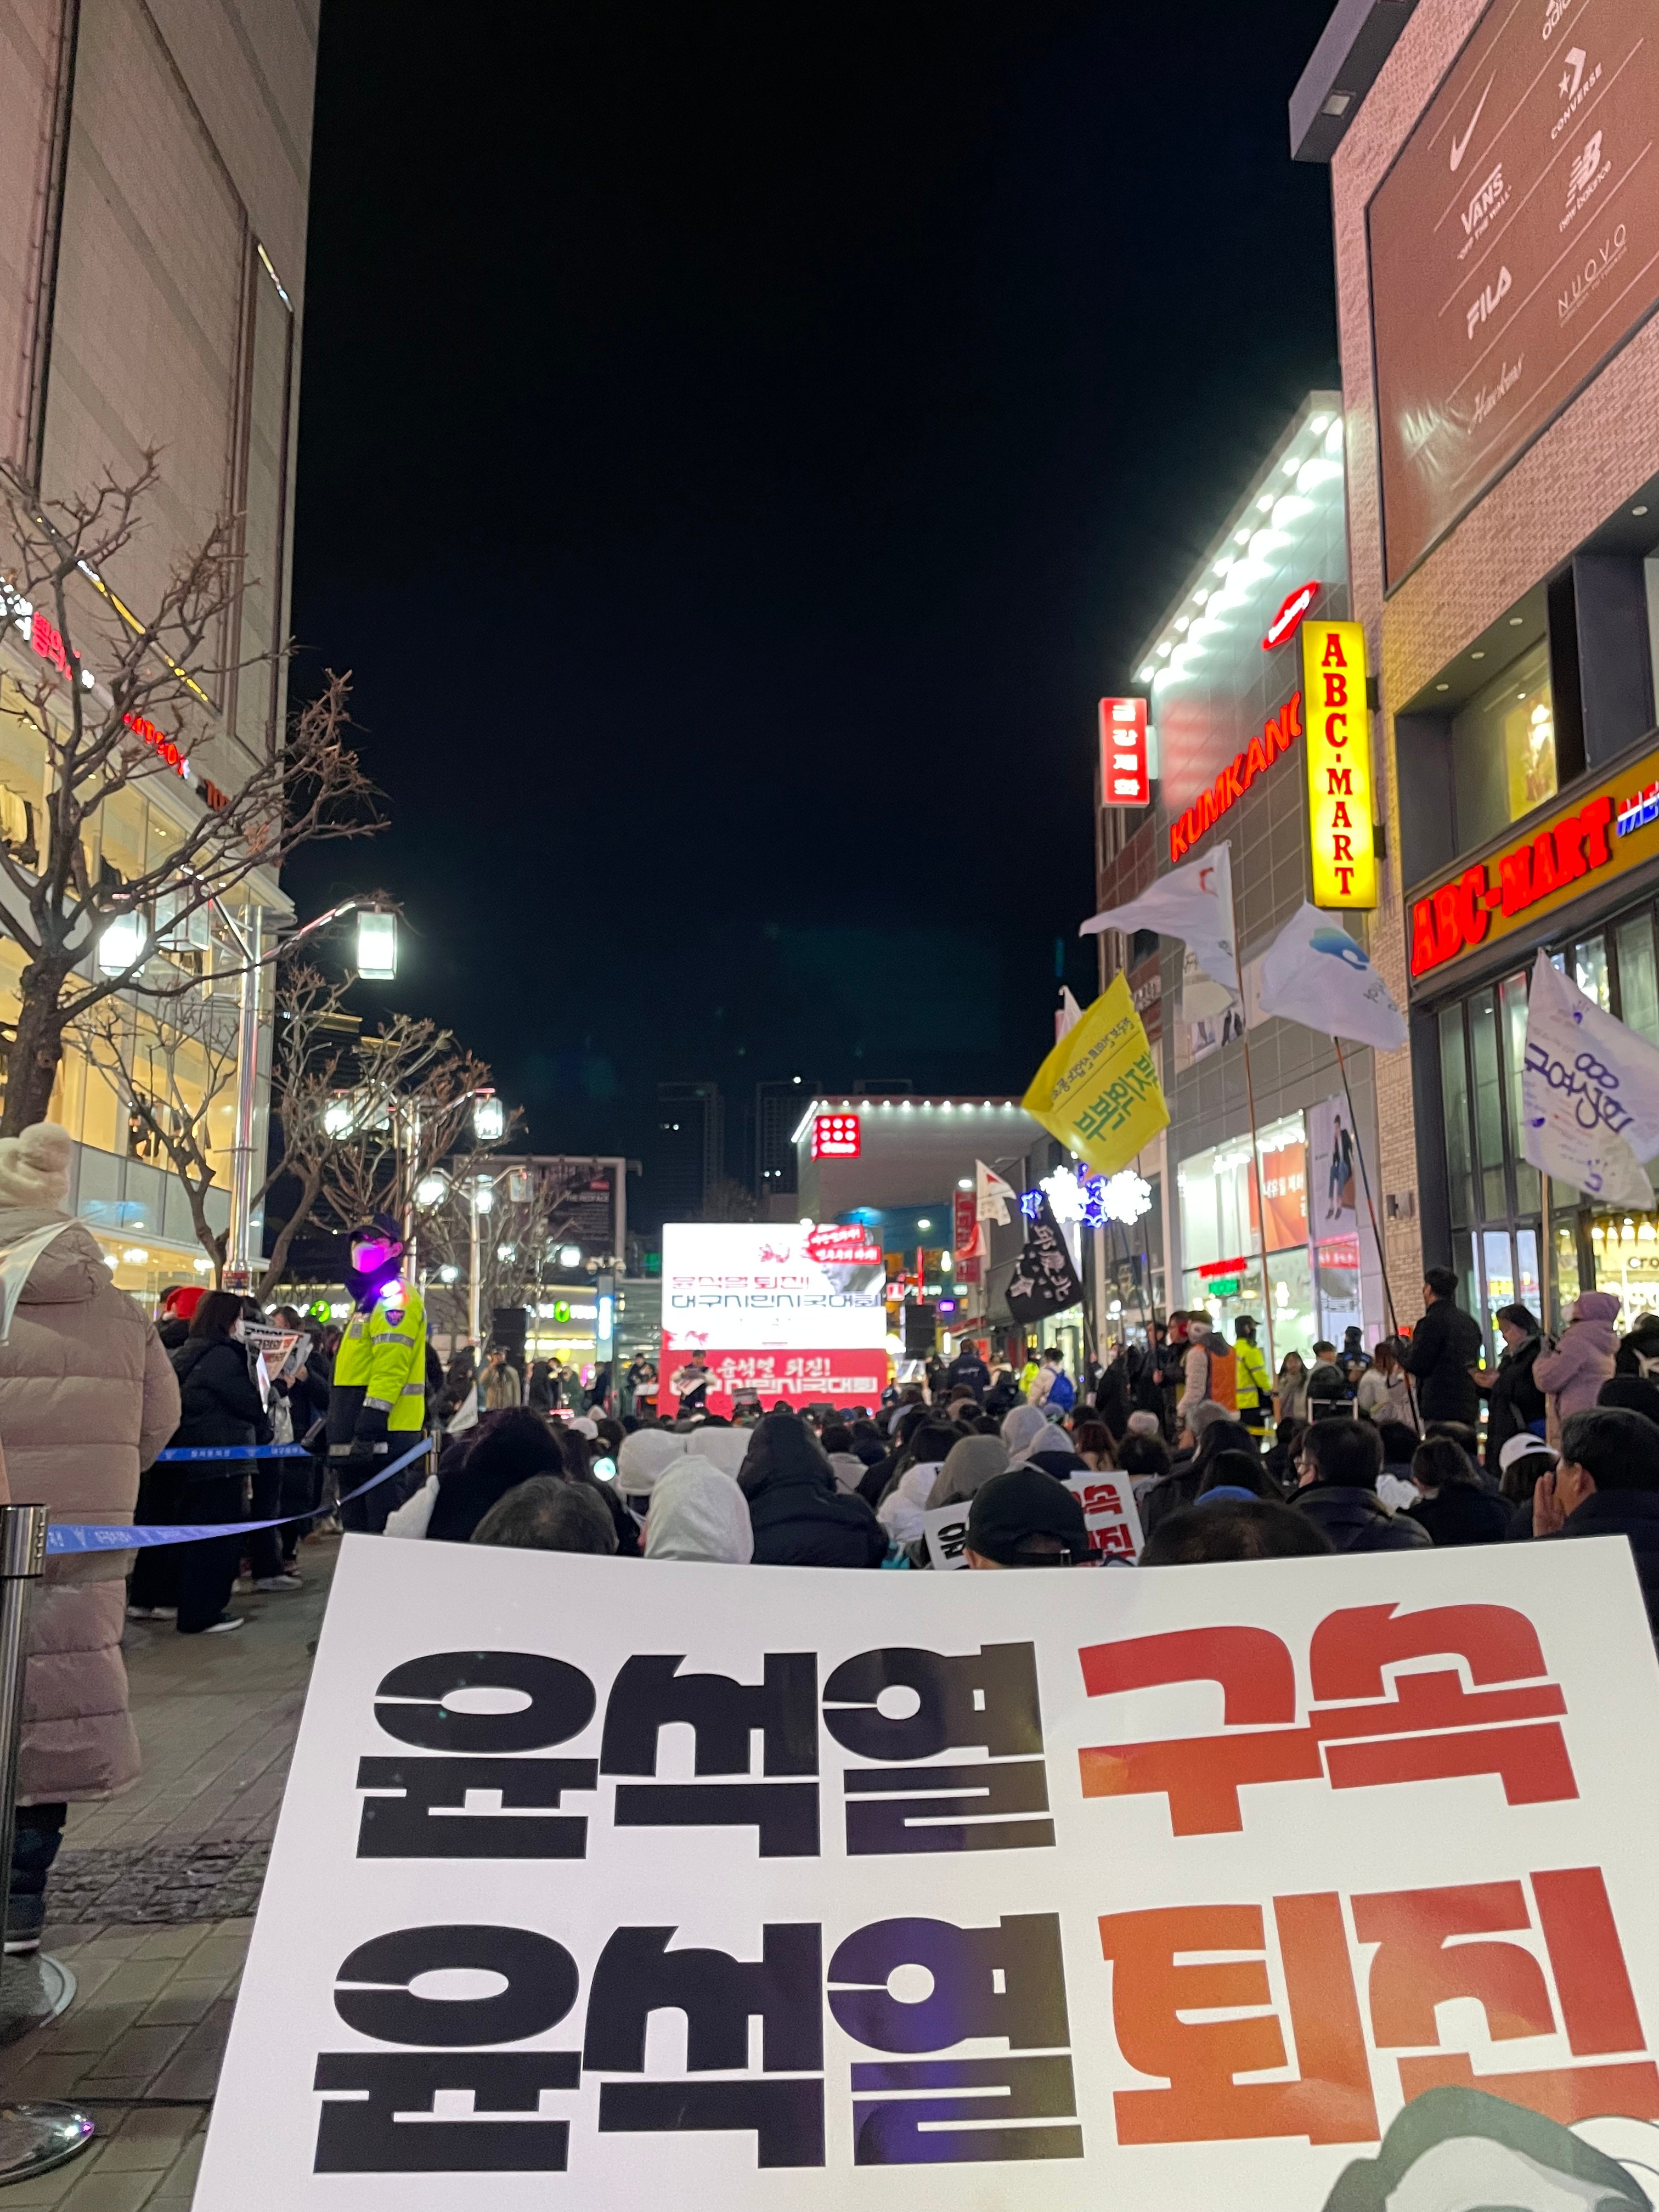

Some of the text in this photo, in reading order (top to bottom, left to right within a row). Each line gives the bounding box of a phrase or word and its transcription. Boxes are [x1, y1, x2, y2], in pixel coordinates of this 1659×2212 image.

[1551, 62, 1602, 140] CONVERSE
[1460, 162, 1503, 235] VANS
[1465, 266, 1512, 340] FILA
[1558, 224, 1626, 317] NUOVO
[1321, 634, 1353, 895] ABC-MART
[1411, 795, 1612, 976] ABC-MART
[672, 1294, 880, 1308] 대구시민시국대회
[673, 1276, 748, 1290] 윤석열
[717, 1357, 832, 1379] 윤석열 퇴진!
[357, 1603, 1579, 1860] 윤석열 구속
[313, 1867, 1659, 2174] 윤석열 퇴진
